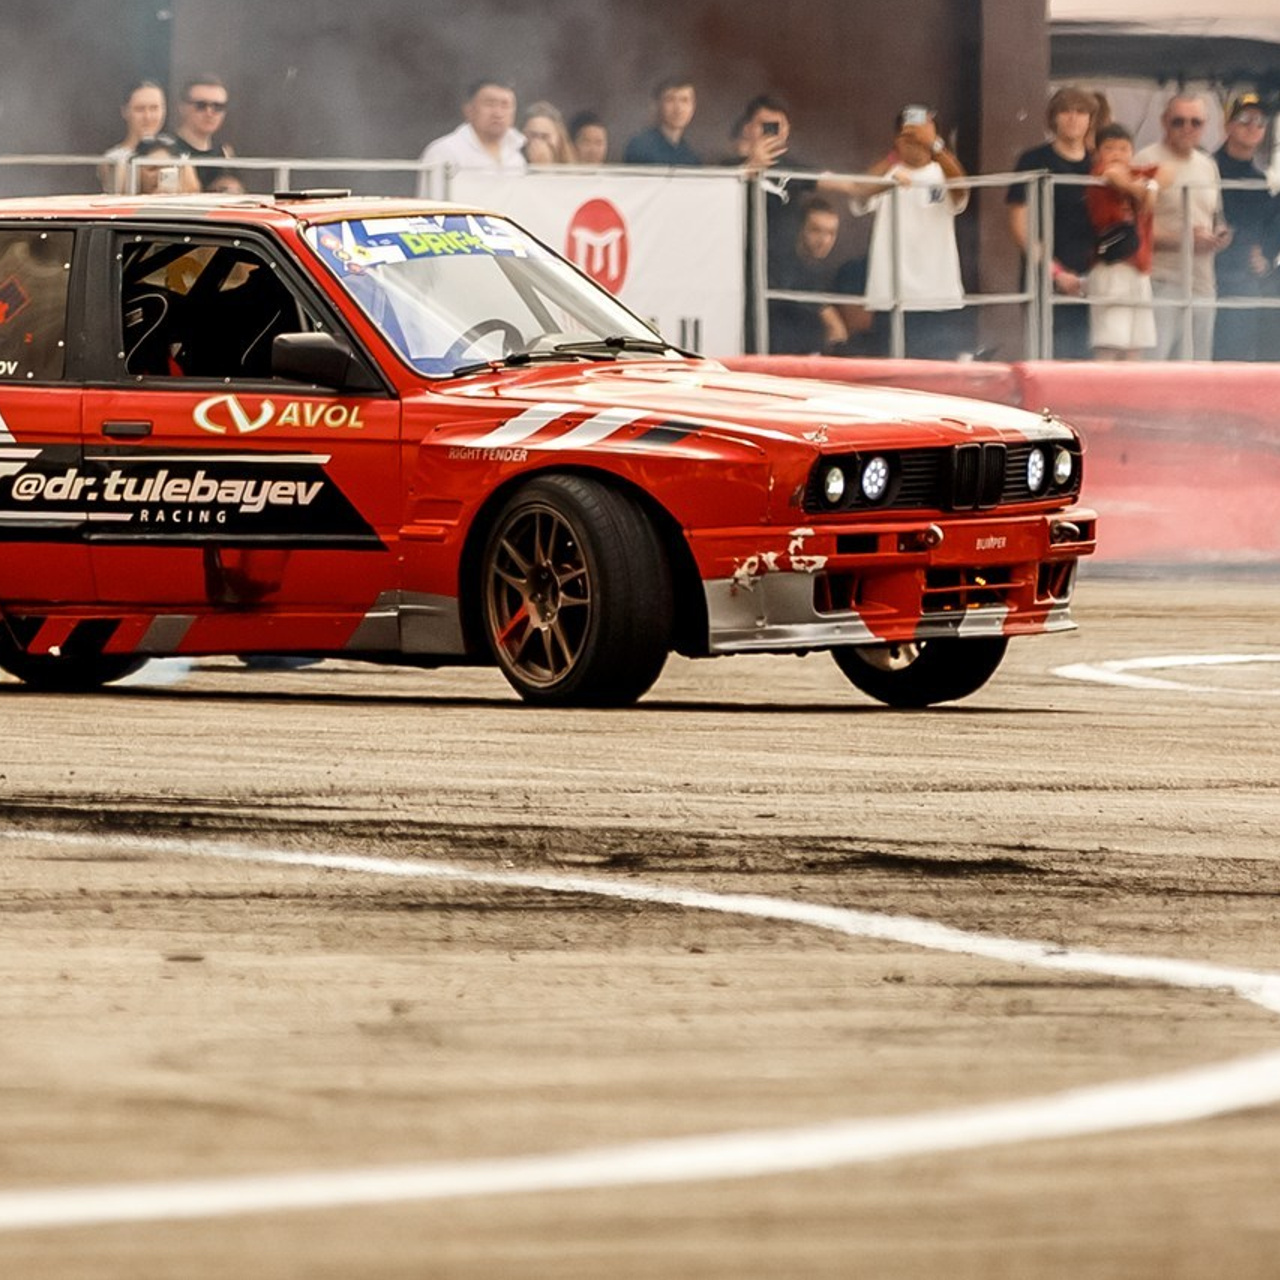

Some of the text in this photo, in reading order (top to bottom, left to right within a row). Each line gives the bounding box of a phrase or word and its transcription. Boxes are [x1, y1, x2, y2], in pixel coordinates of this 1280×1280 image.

[275, 401, 365, 429] AVOL
[448, 447, 529, 462] RIGHT FENDER
[11, 468, 325, 513] @dr.tulebayev
[139, 509, 227, 524] RACING
